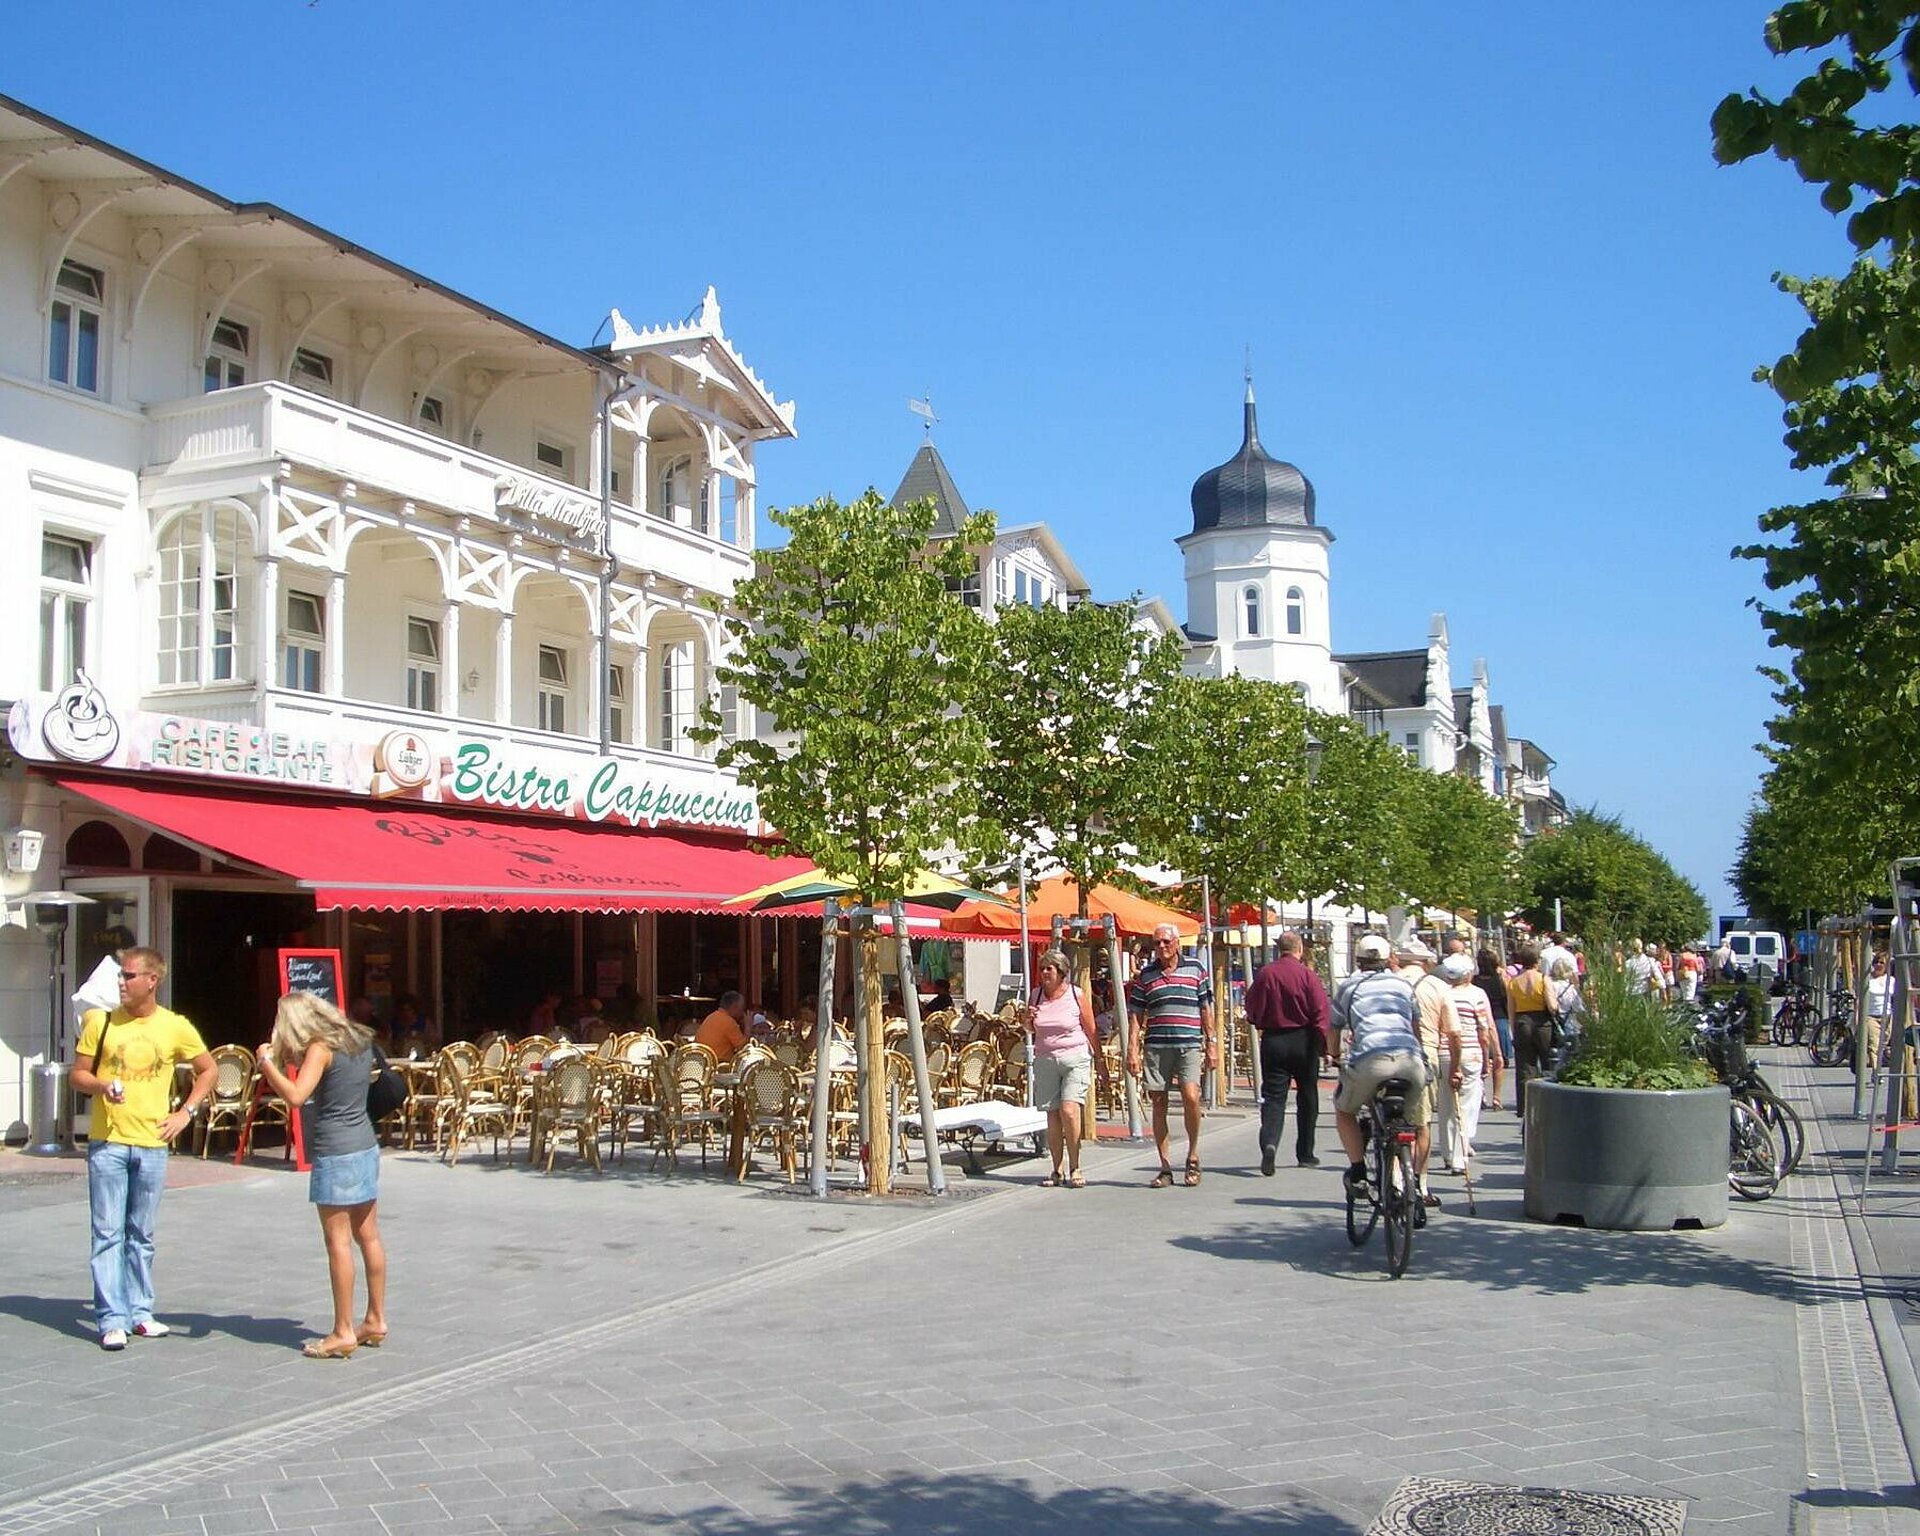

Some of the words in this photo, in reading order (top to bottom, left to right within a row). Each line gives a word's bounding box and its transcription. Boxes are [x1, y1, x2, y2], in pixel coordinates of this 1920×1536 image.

[152, 739, 333, 783] RISTORANTE
[272, 732, 328, 762] BAR
[454, 743, 570, 803] Bistro
[586, 761, 754, 822] Cappuccino
